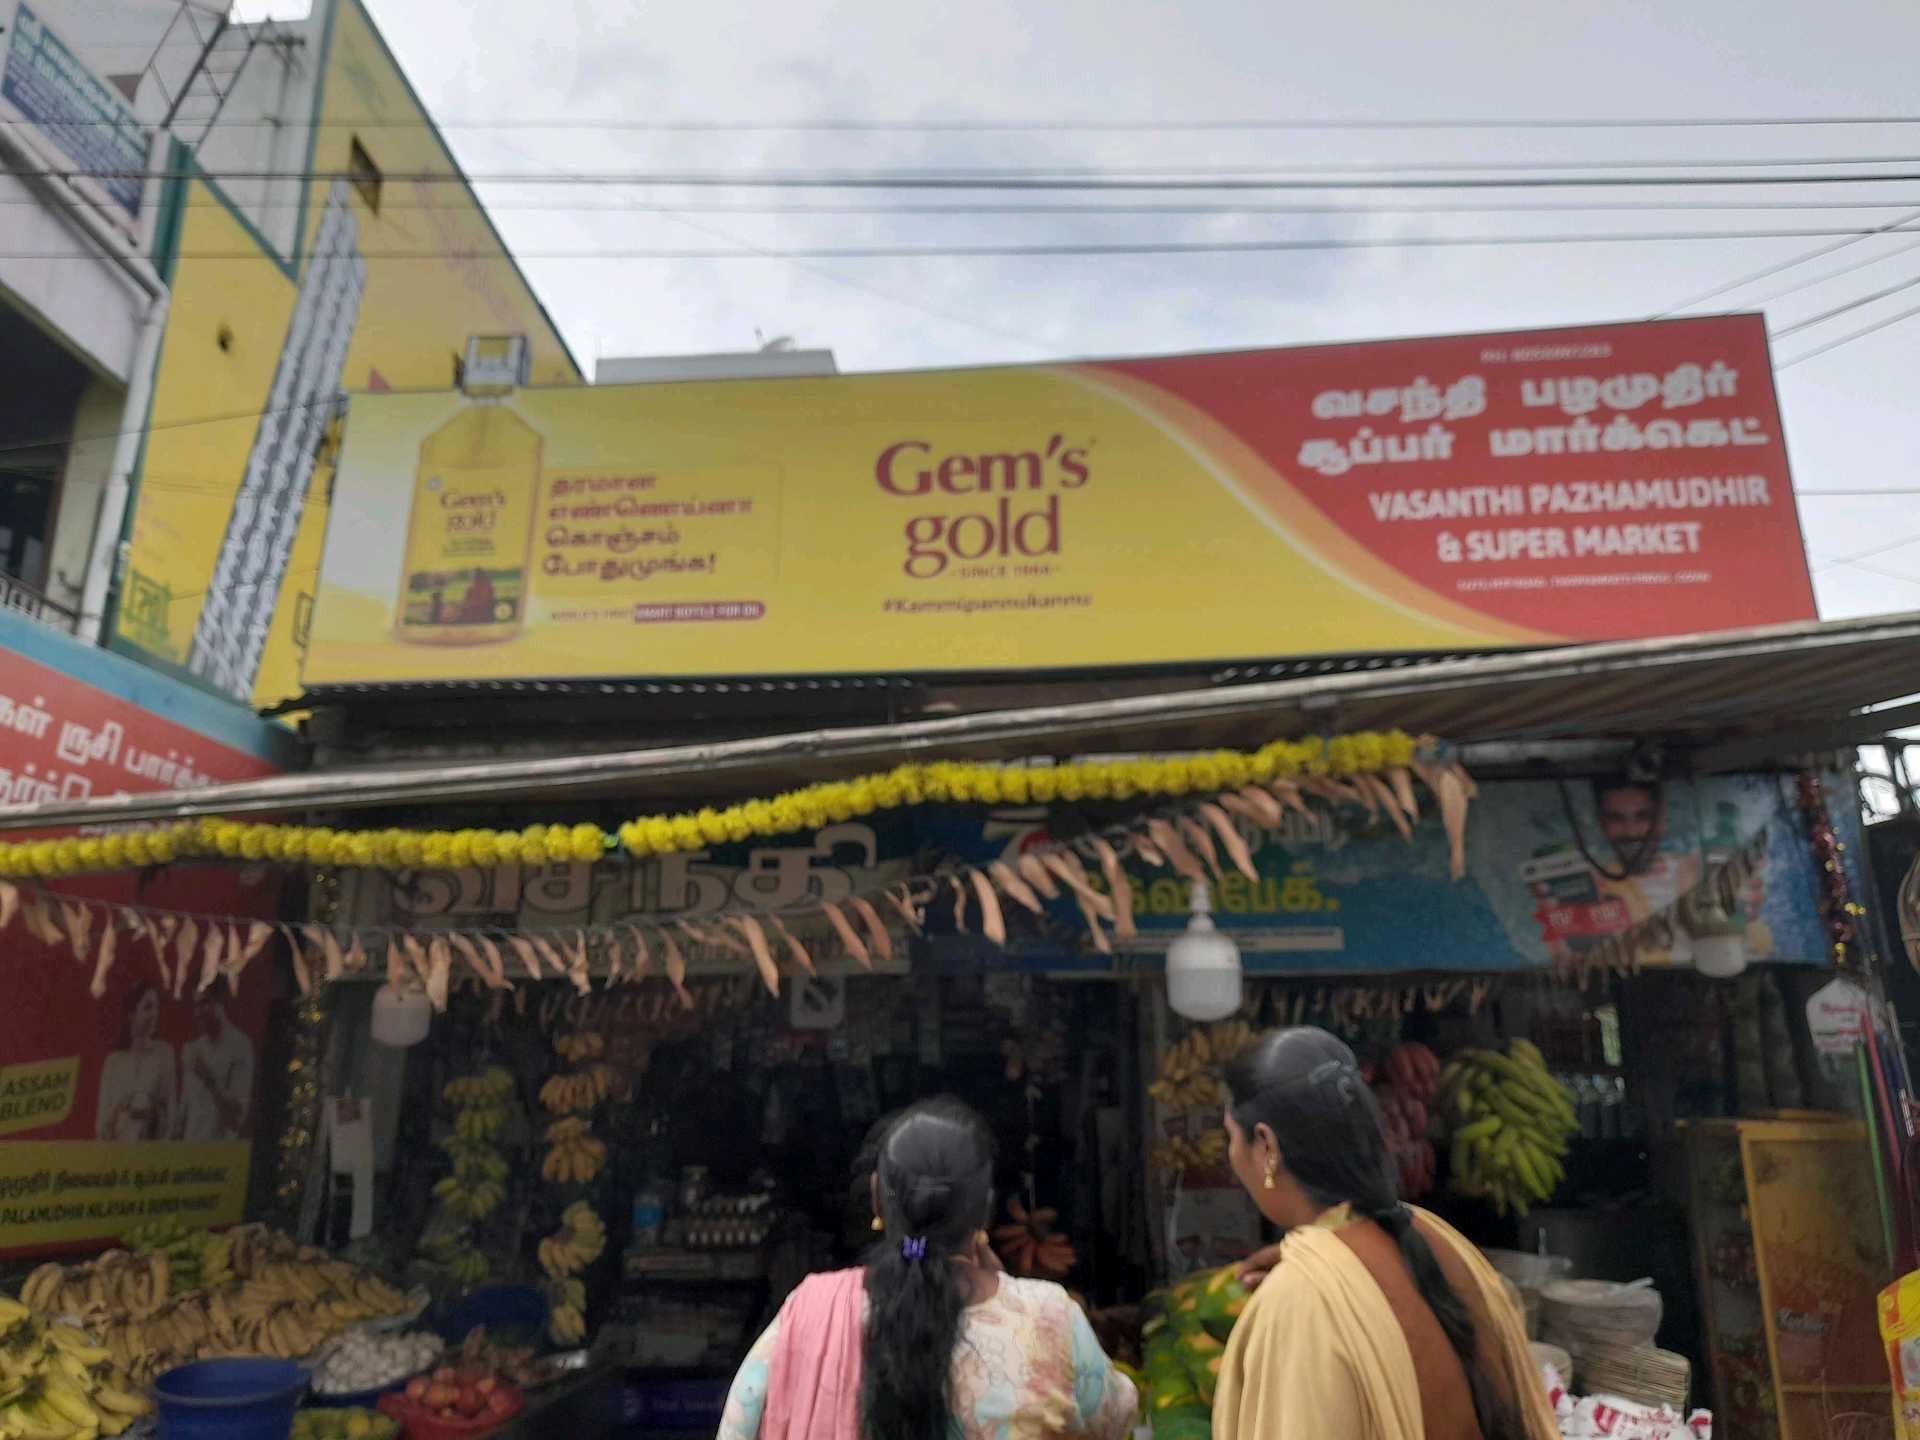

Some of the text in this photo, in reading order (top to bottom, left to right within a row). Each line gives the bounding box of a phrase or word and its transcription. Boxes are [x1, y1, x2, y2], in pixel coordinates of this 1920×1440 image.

[1311, 360, 1739, 423] வசந்தி பழமுதிர்
[875, 434, 1089, 496] Gem's
[1297, 413, 1771, 476] சூப்பர் மார்க்கெட்
[1369, 475, 1771, 522] VASANTHI PAZHAMUDHIR
[903, 495, 1060, 579] gold
[1436, 522, 1701, 562] & SUPER MARKET
[3, 1072, 70, 1095] ASSAM
